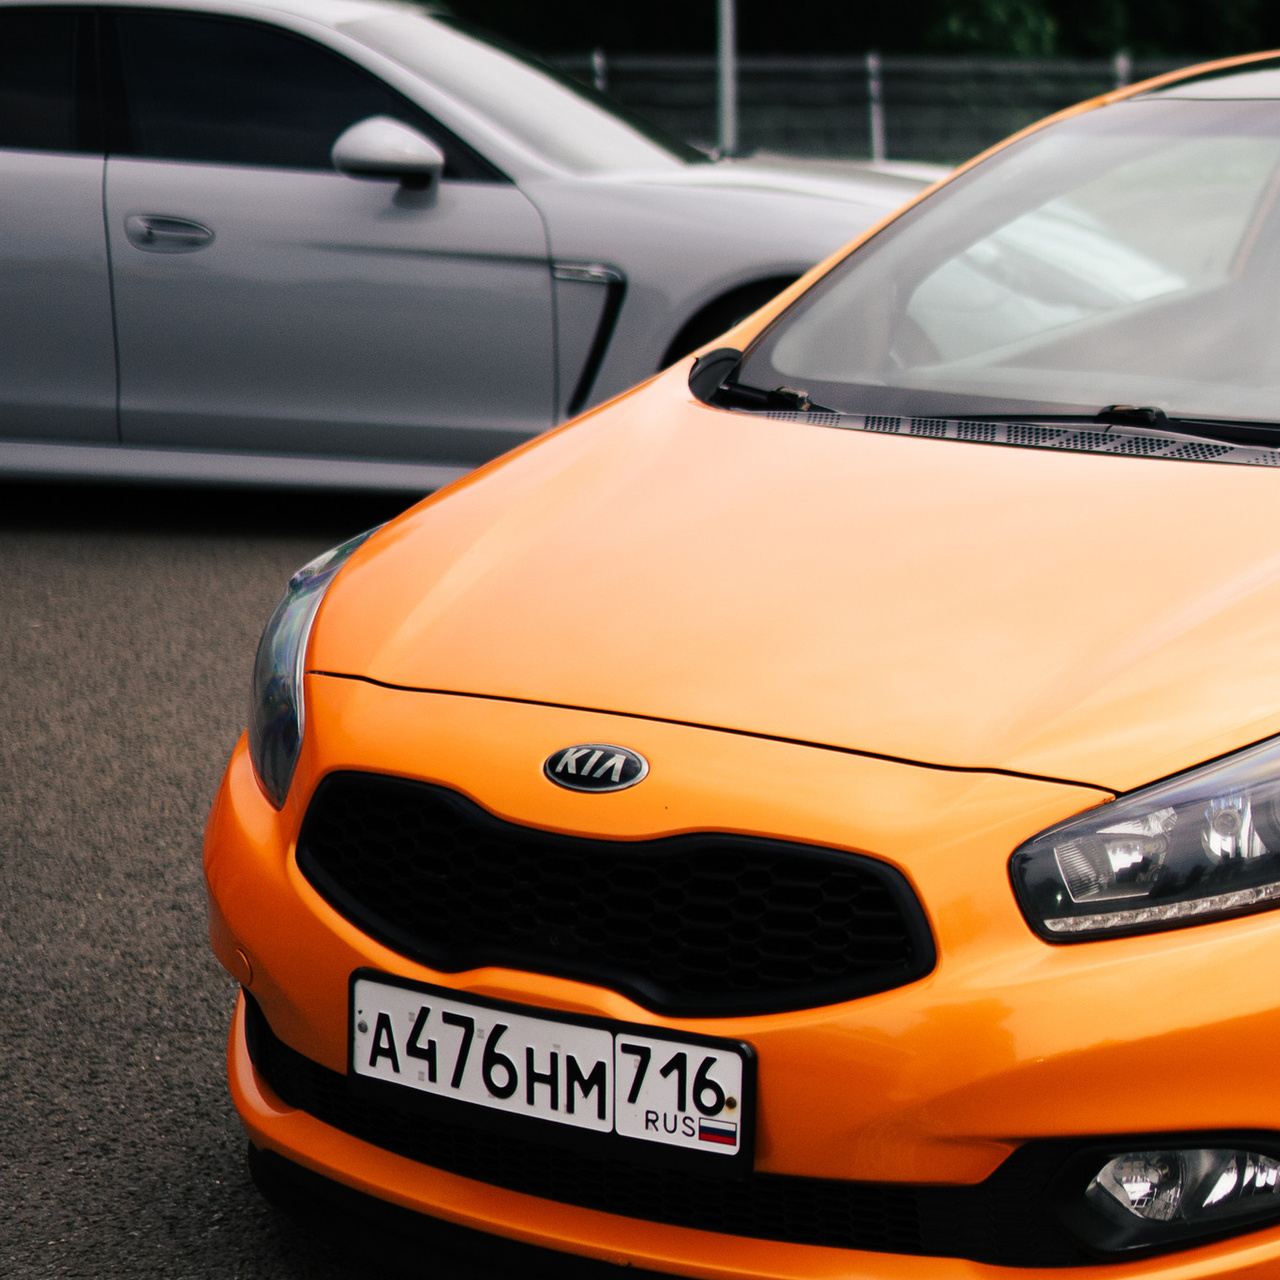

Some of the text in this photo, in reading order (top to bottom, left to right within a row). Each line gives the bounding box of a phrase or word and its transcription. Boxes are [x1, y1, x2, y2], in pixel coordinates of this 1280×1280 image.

[555, 747, 627, 783] KIA
[620, 1042, 727, 1117] 716
[645, 1110, 696, 1138] RUS
